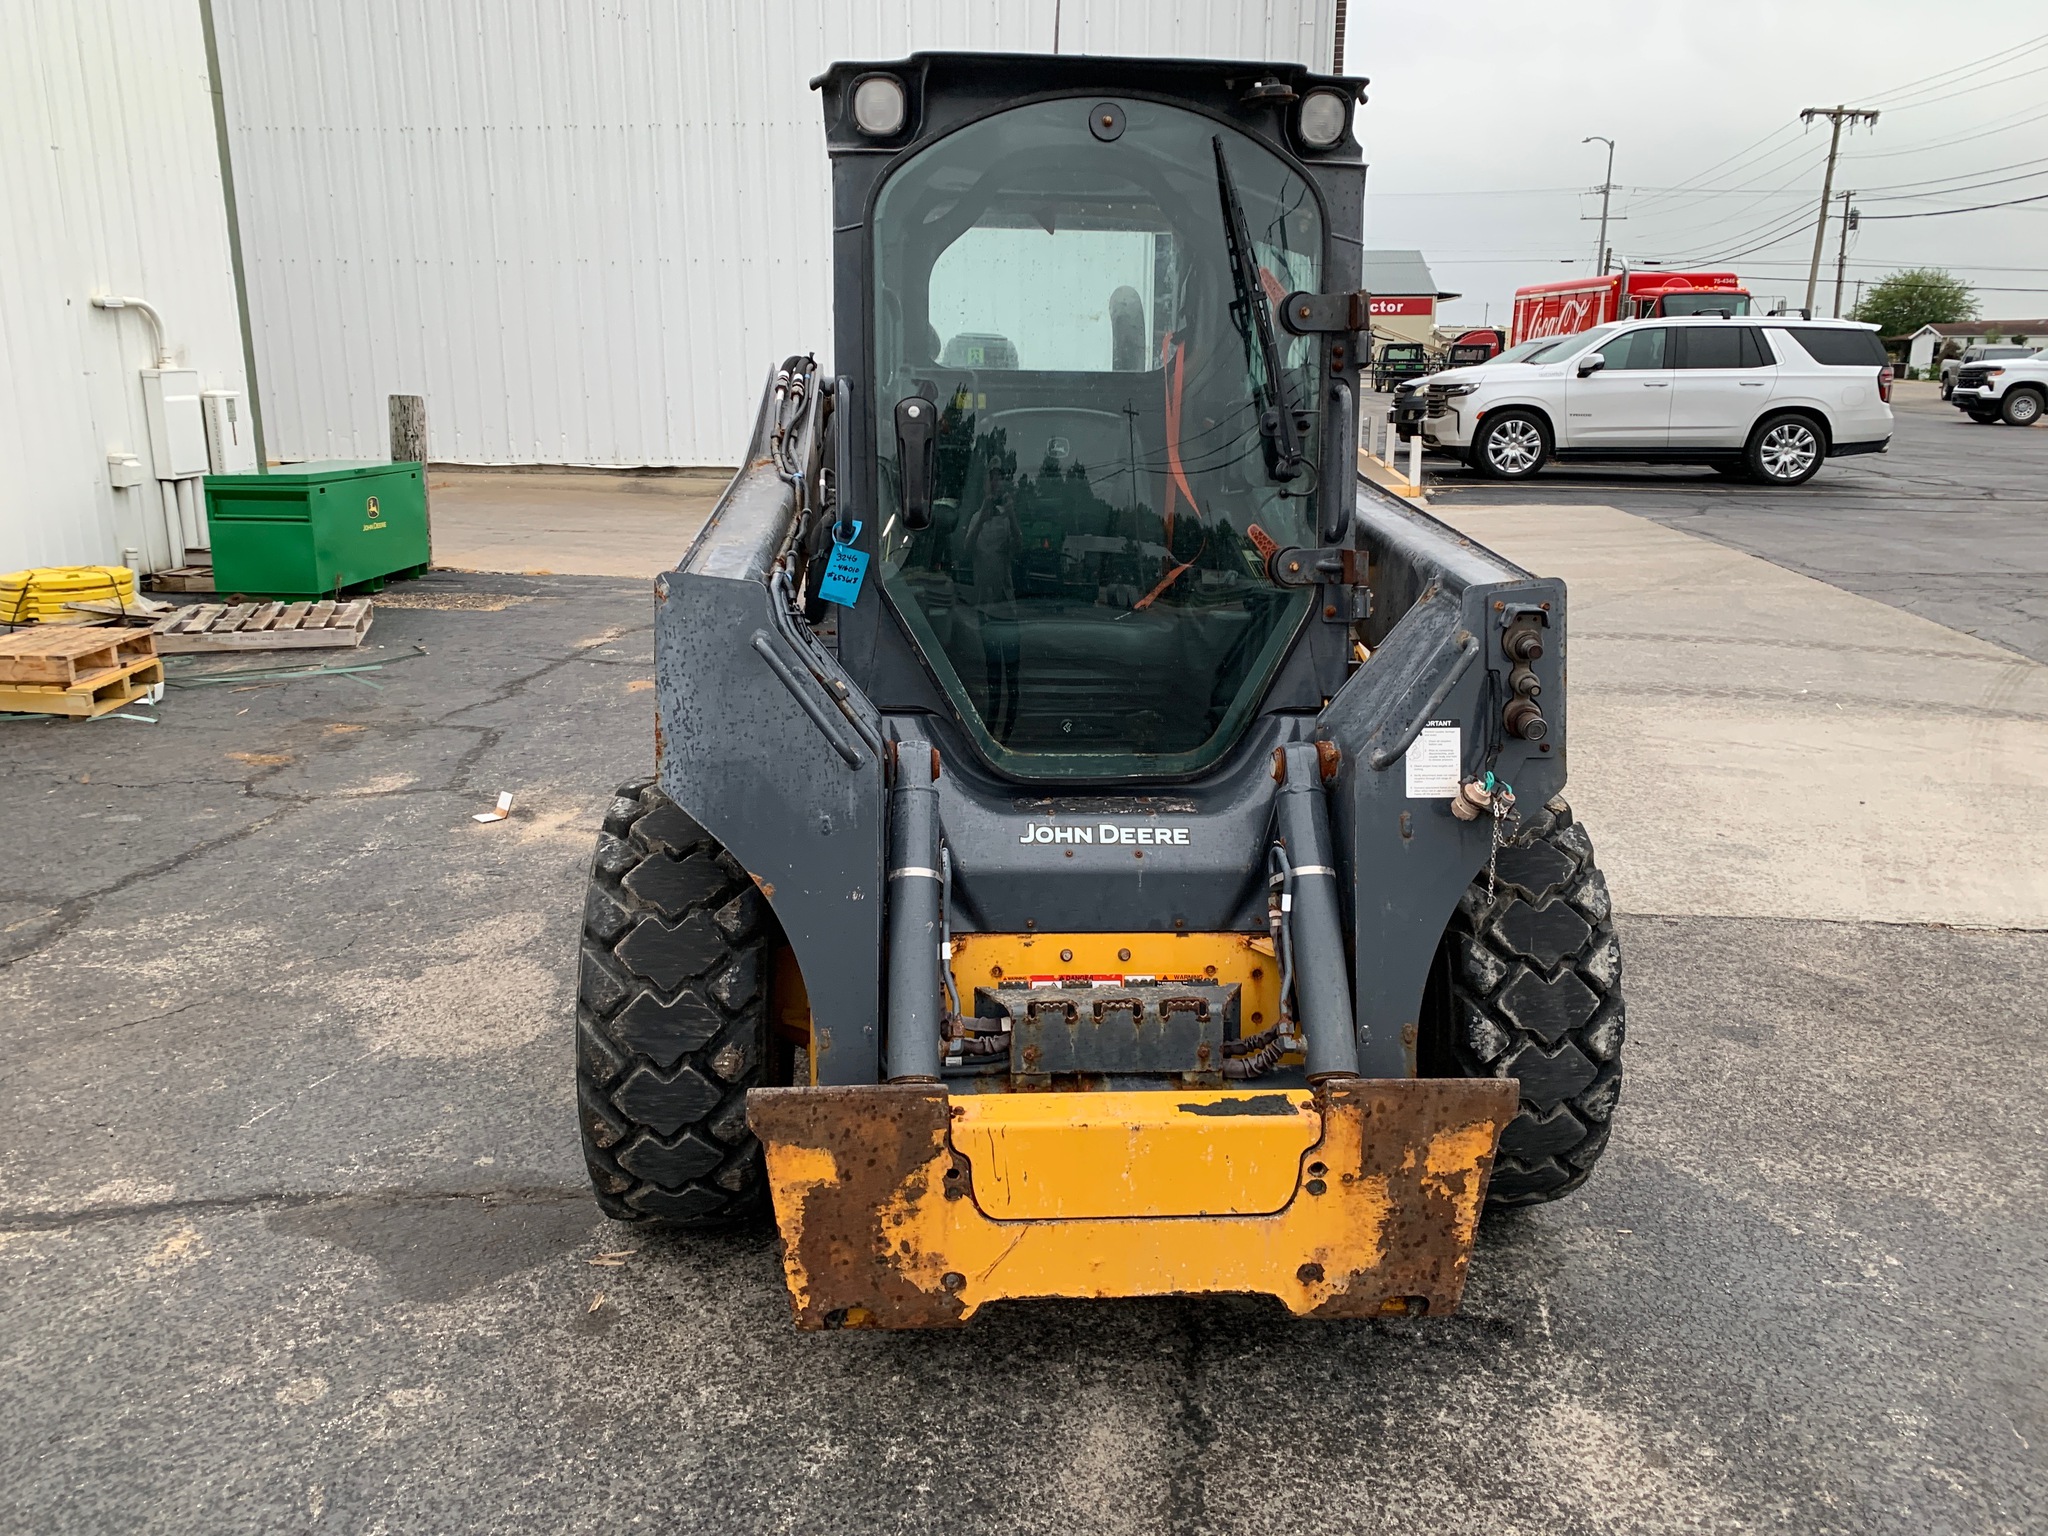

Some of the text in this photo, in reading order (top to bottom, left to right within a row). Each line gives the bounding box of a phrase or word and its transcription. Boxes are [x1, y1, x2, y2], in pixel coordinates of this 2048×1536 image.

[1370, 301, 1404, 313] ctor
[1020, 823, 1190, 845] JOHN DEERE
